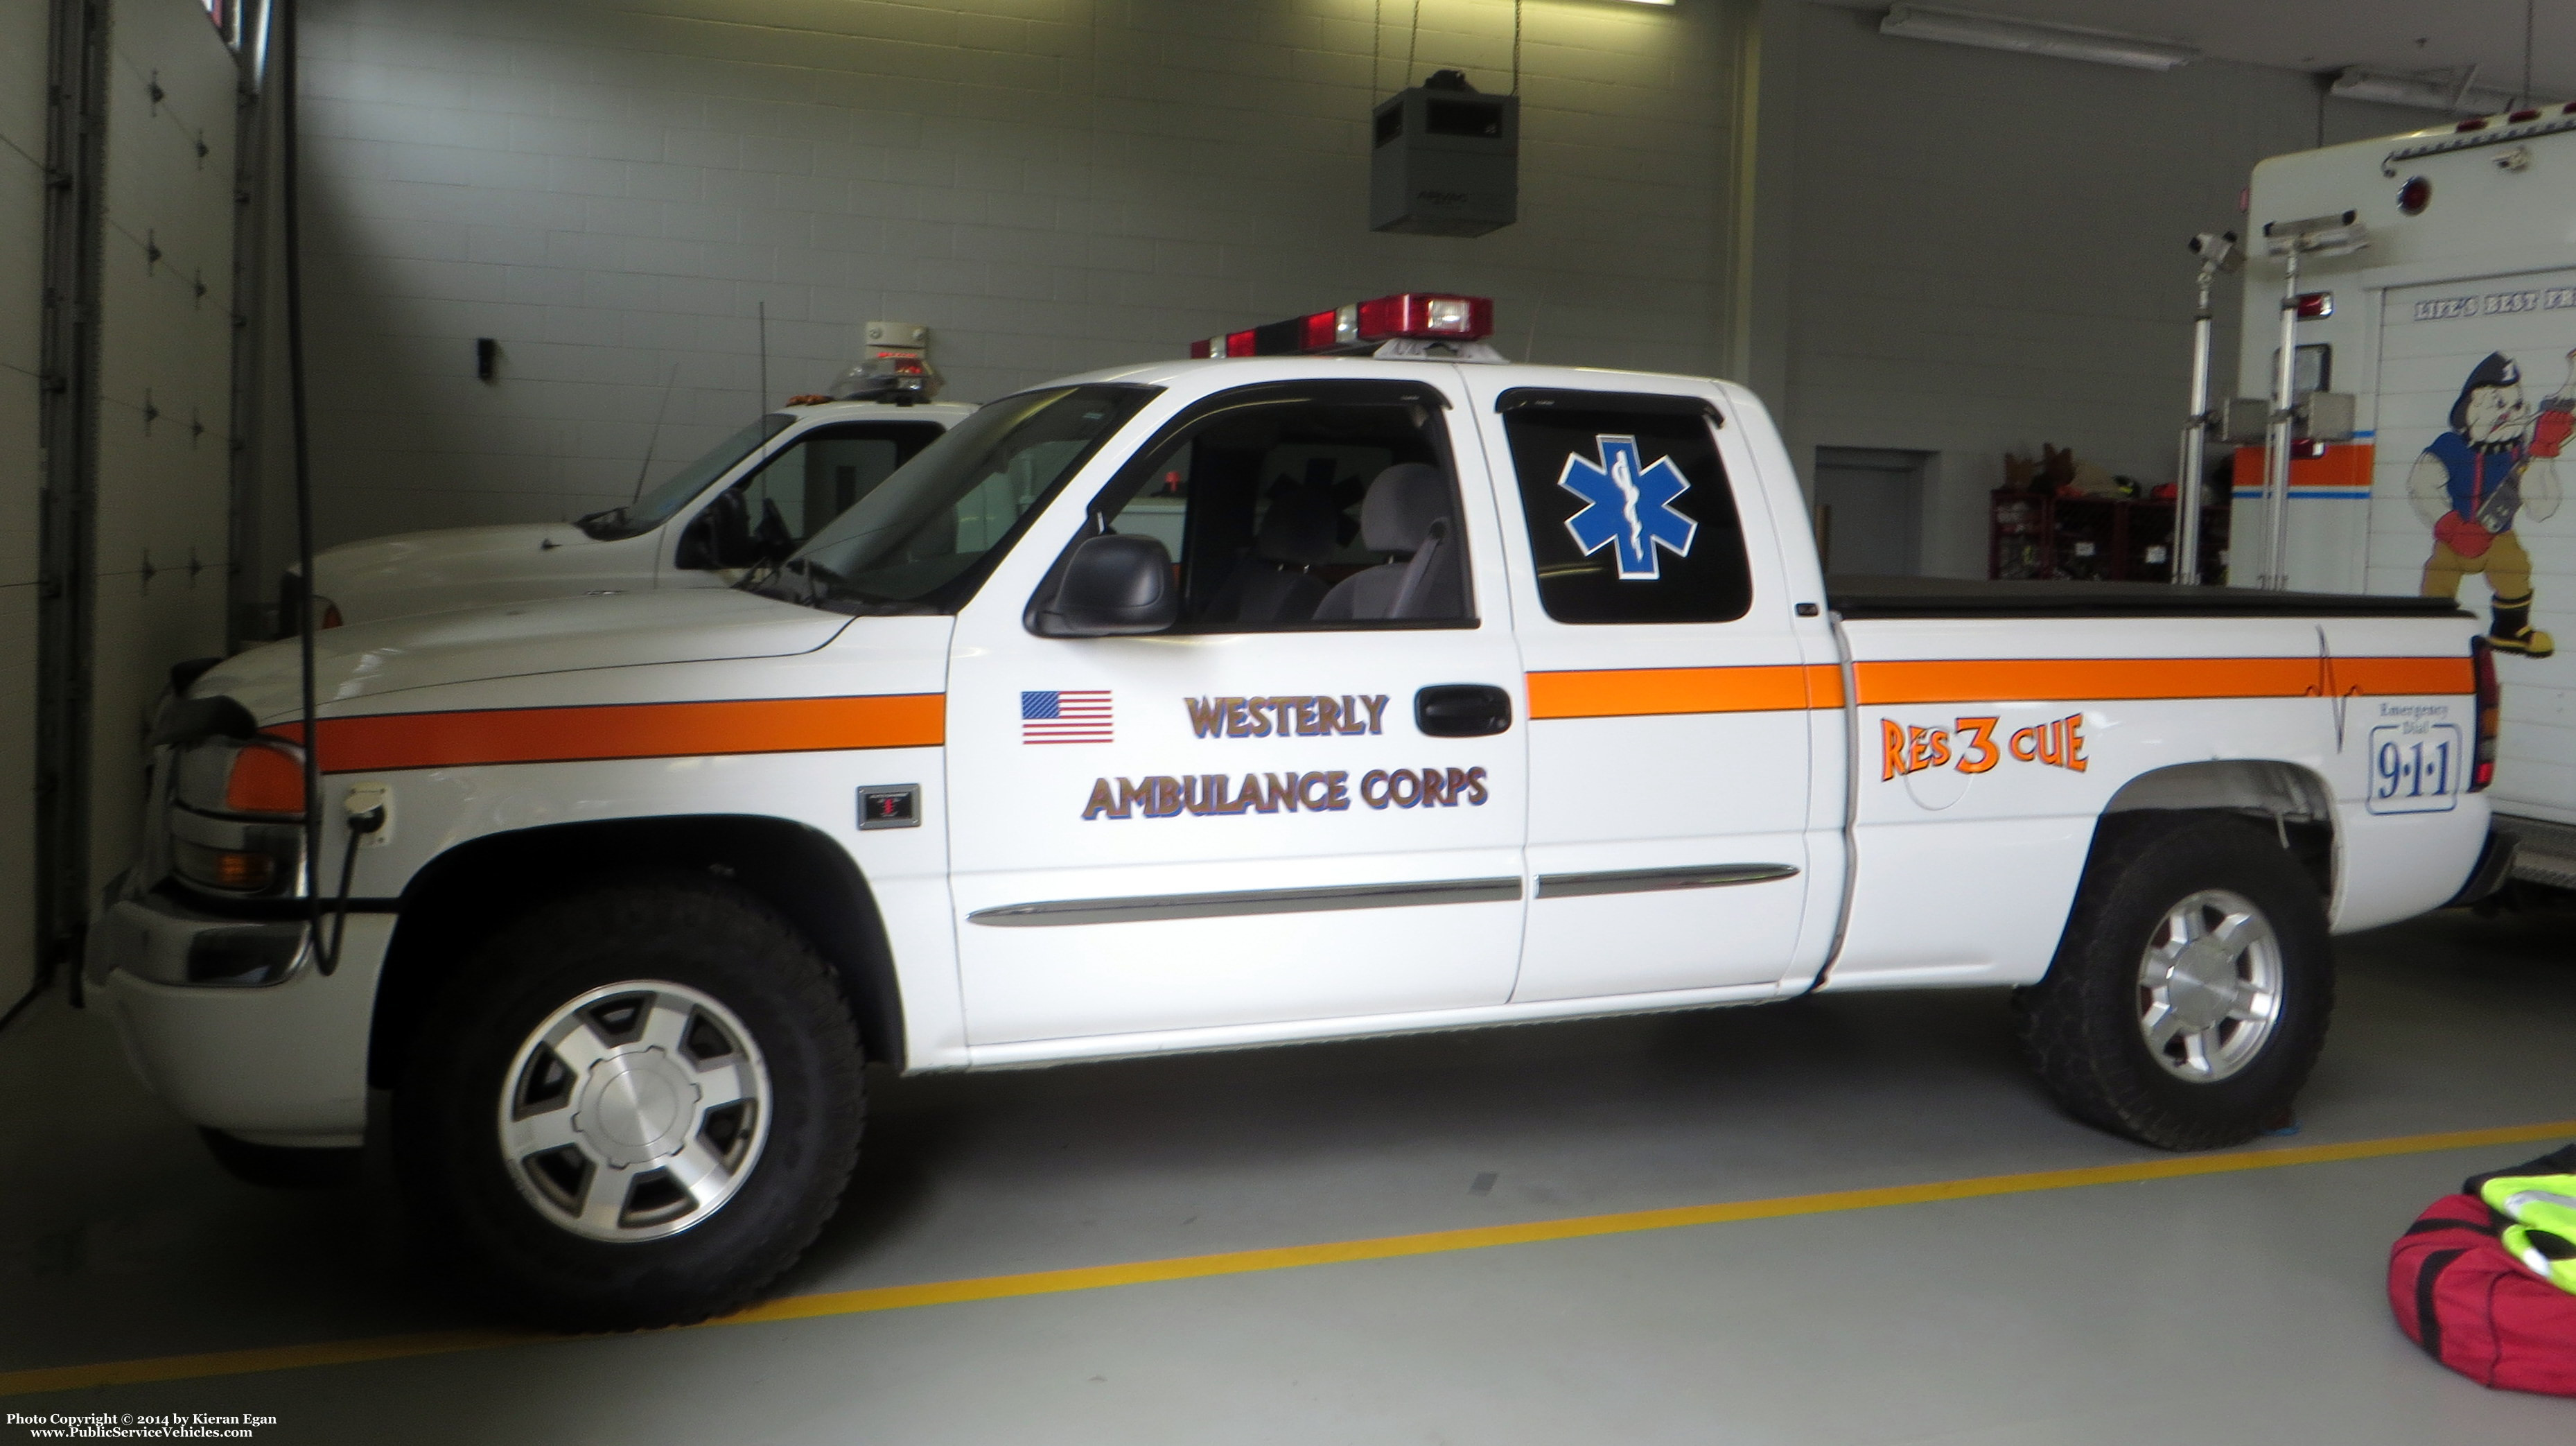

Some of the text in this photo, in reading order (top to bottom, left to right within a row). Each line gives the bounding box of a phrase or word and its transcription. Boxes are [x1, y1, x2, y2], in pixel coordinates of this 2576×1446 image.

[2484, 290, 2540, 315] BEST
[2543, 287, 2576, 310] FR
[1183, 694, 1390, 740] WESTERLY
[2379, 702, 2449, 720] Emergency
[1954, 715, 2001, 775] 3
[2009, 711, 2089, 774] CUE
[1081, 766, 1489, 821] AMBULANCE CORPS
